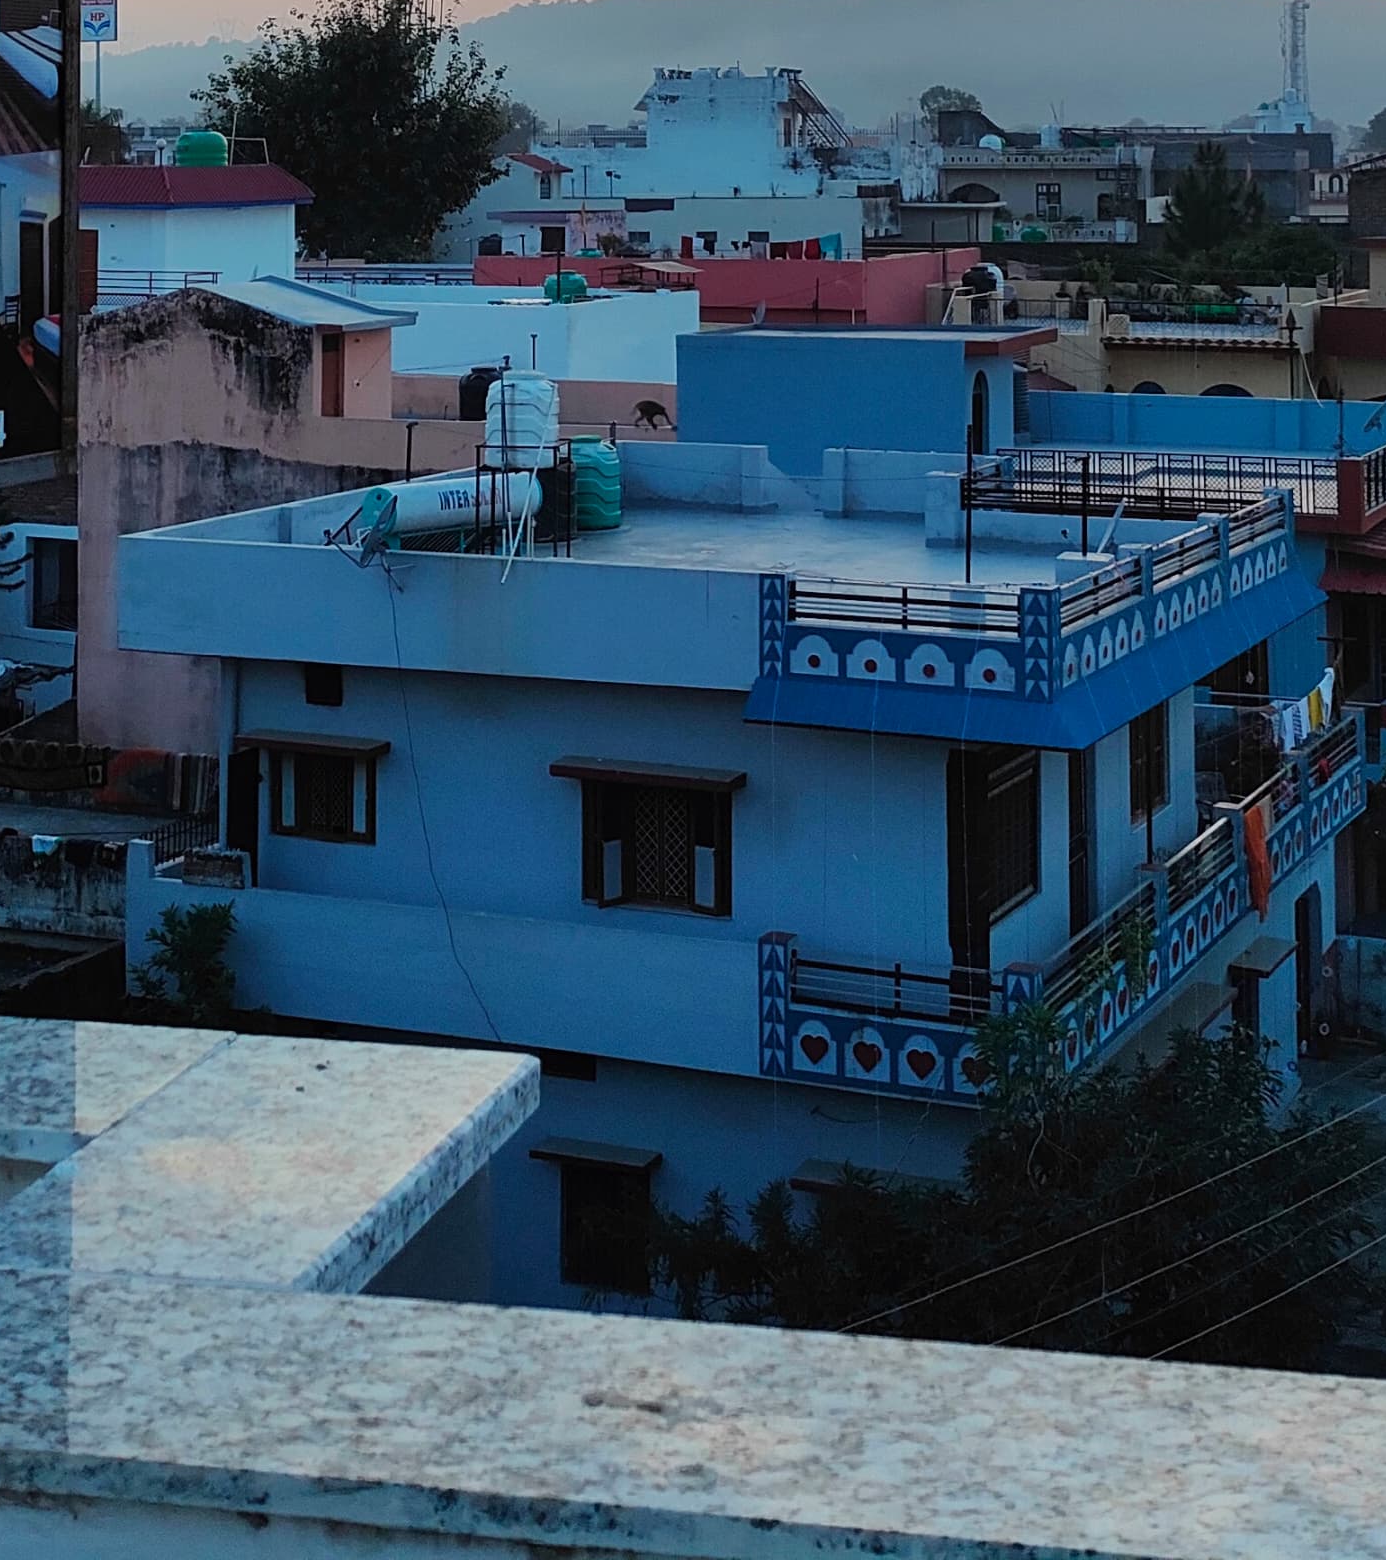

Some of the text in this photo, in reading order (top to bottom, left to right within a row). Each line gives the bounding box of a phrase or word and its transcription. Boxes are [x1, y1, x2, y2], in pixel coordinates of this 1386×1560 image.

[90, 12, 105, 22] HP
[438, 487, 502, 511] INTER SOLR
